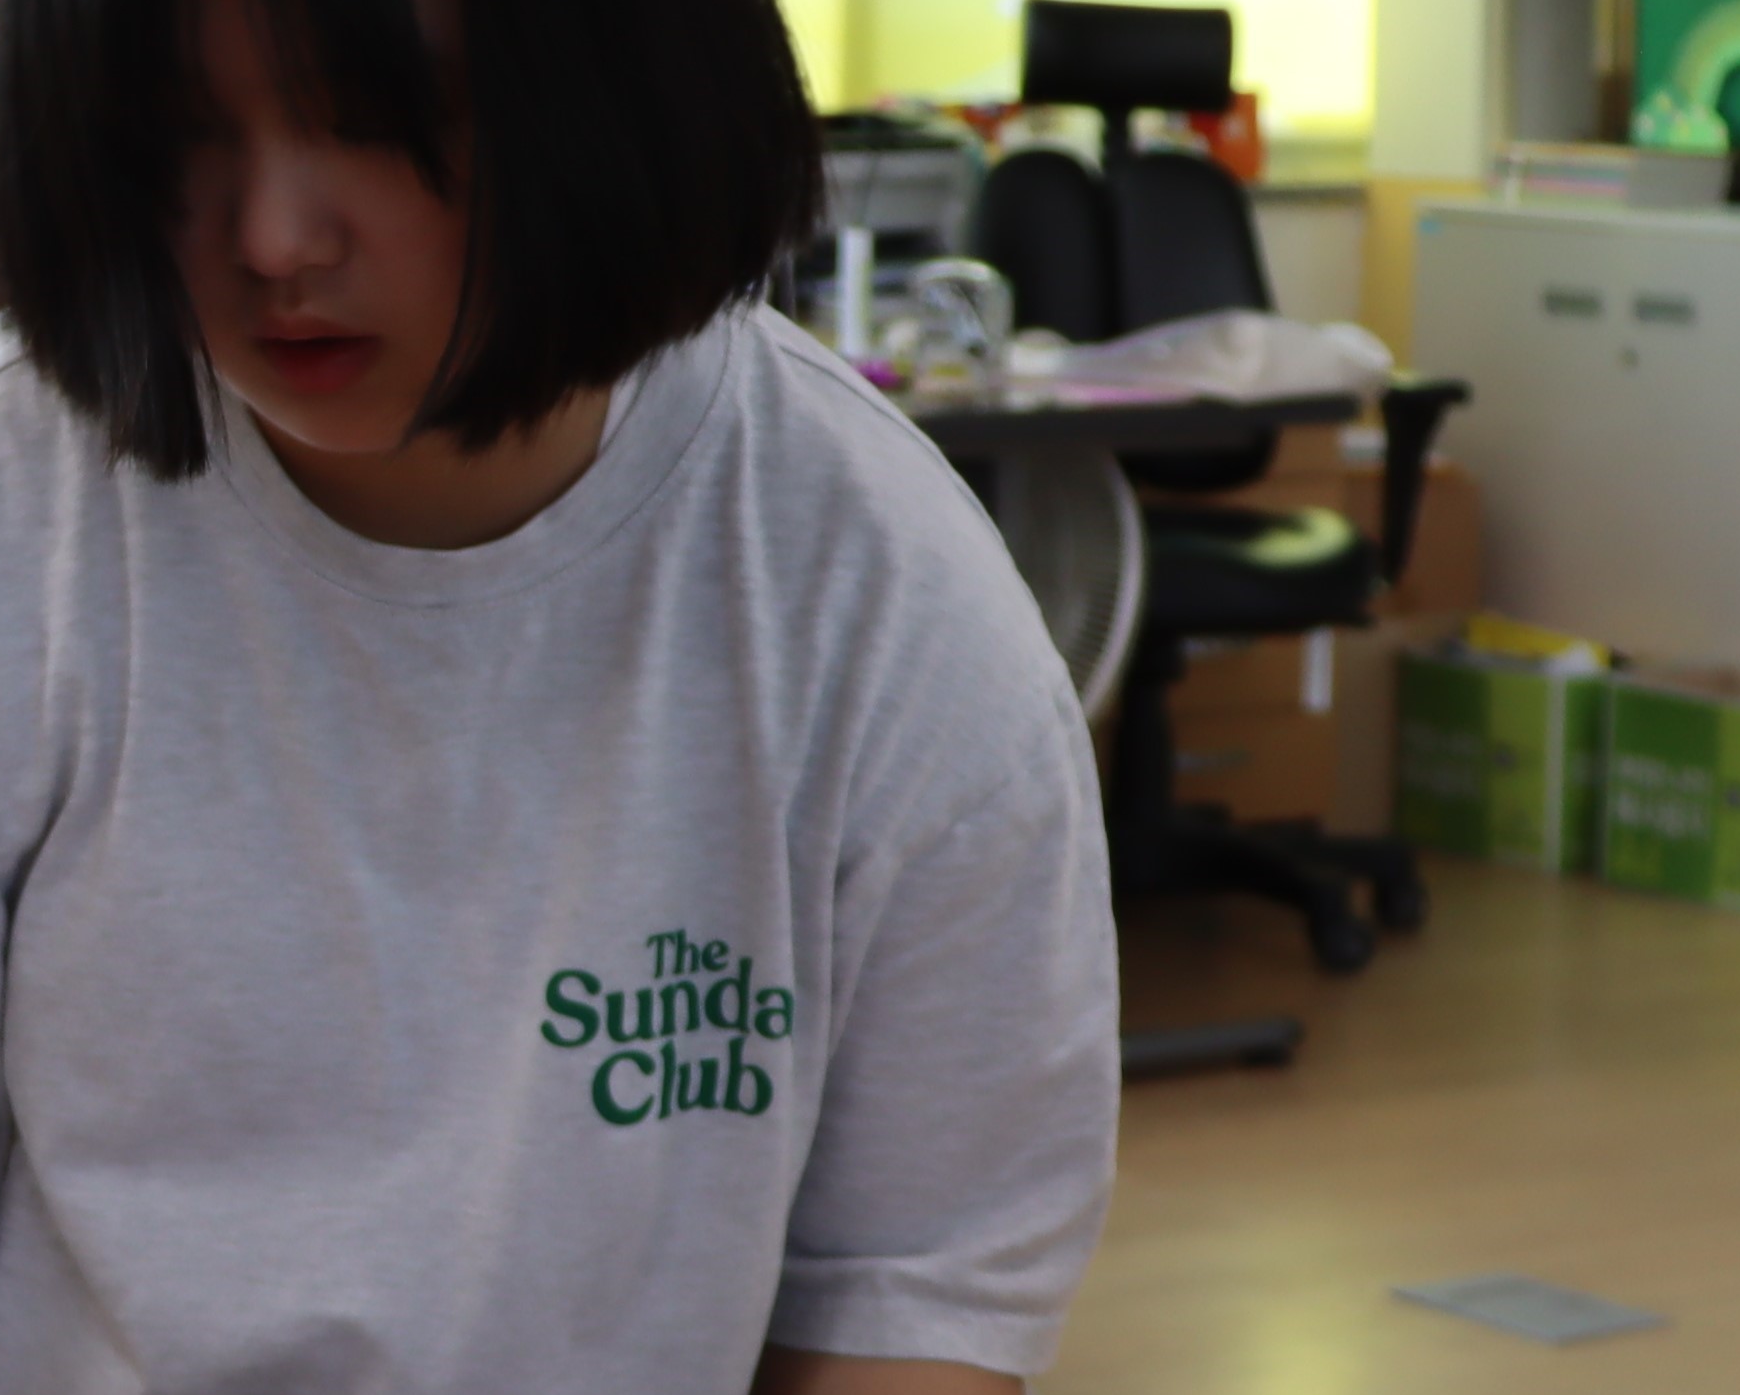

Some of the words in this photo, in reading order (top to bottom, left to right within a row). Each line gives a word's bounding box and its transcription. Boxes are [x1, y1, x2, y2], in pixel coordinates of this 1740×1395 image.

[647, 928, 730, 980] The
[539, 955, 795, 1049] Sunda
[591, 1037, 774, 1126] Club
